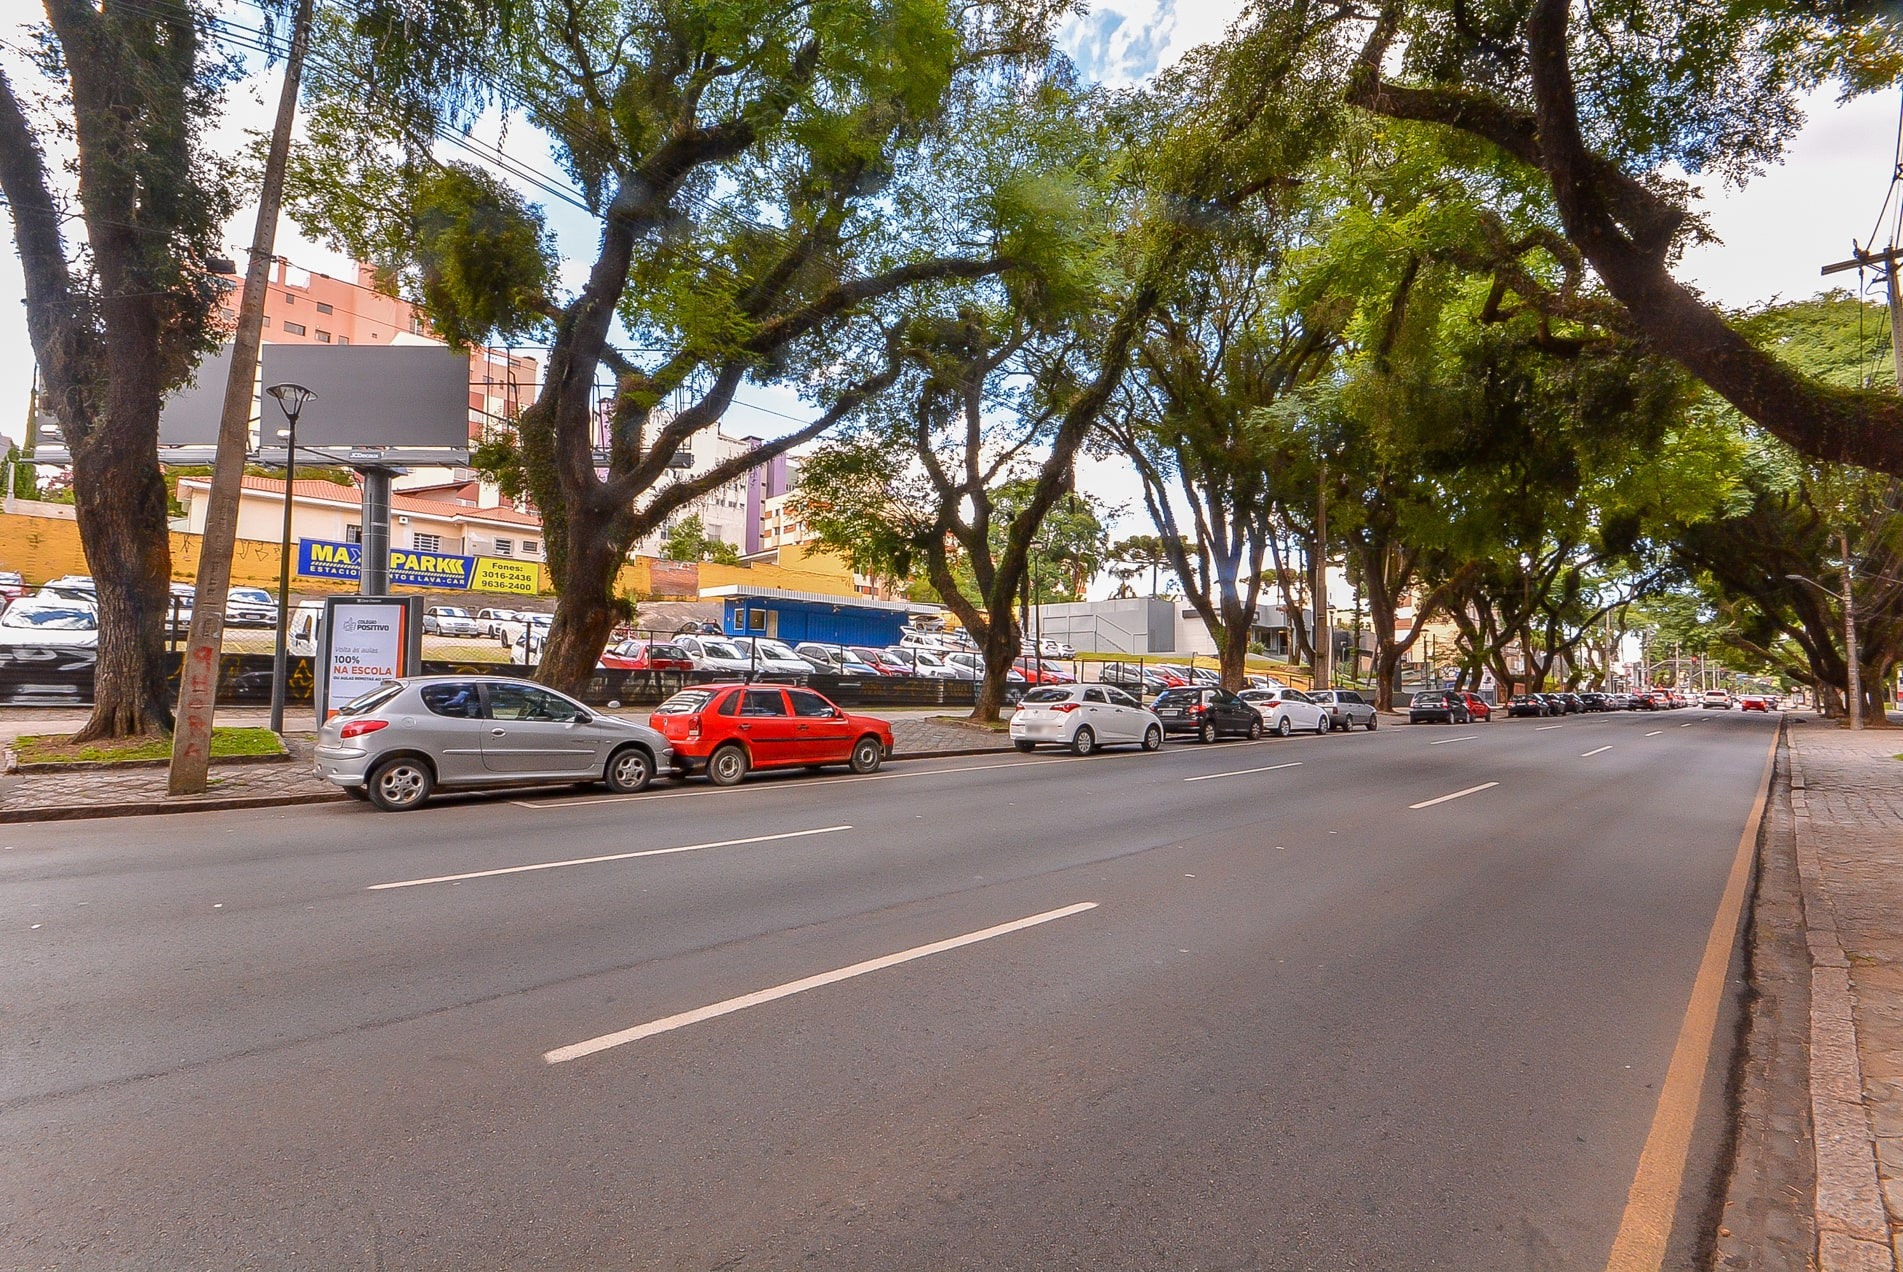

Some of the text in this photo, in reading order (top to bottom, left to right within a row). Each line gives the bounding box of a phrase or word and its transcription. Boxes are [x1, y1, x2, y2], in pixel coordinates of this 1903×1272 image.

[492, 562, 523, 572] Fones:
[418, 576, 465, 585] LAVA-CAR
[482, 571, 532, 582] 3016-2436
[481, 580, 531, 591] 9636-2400
[334, 655, 360, 664] 100%
[334, 665, 392, 676] NA ESCOLA
